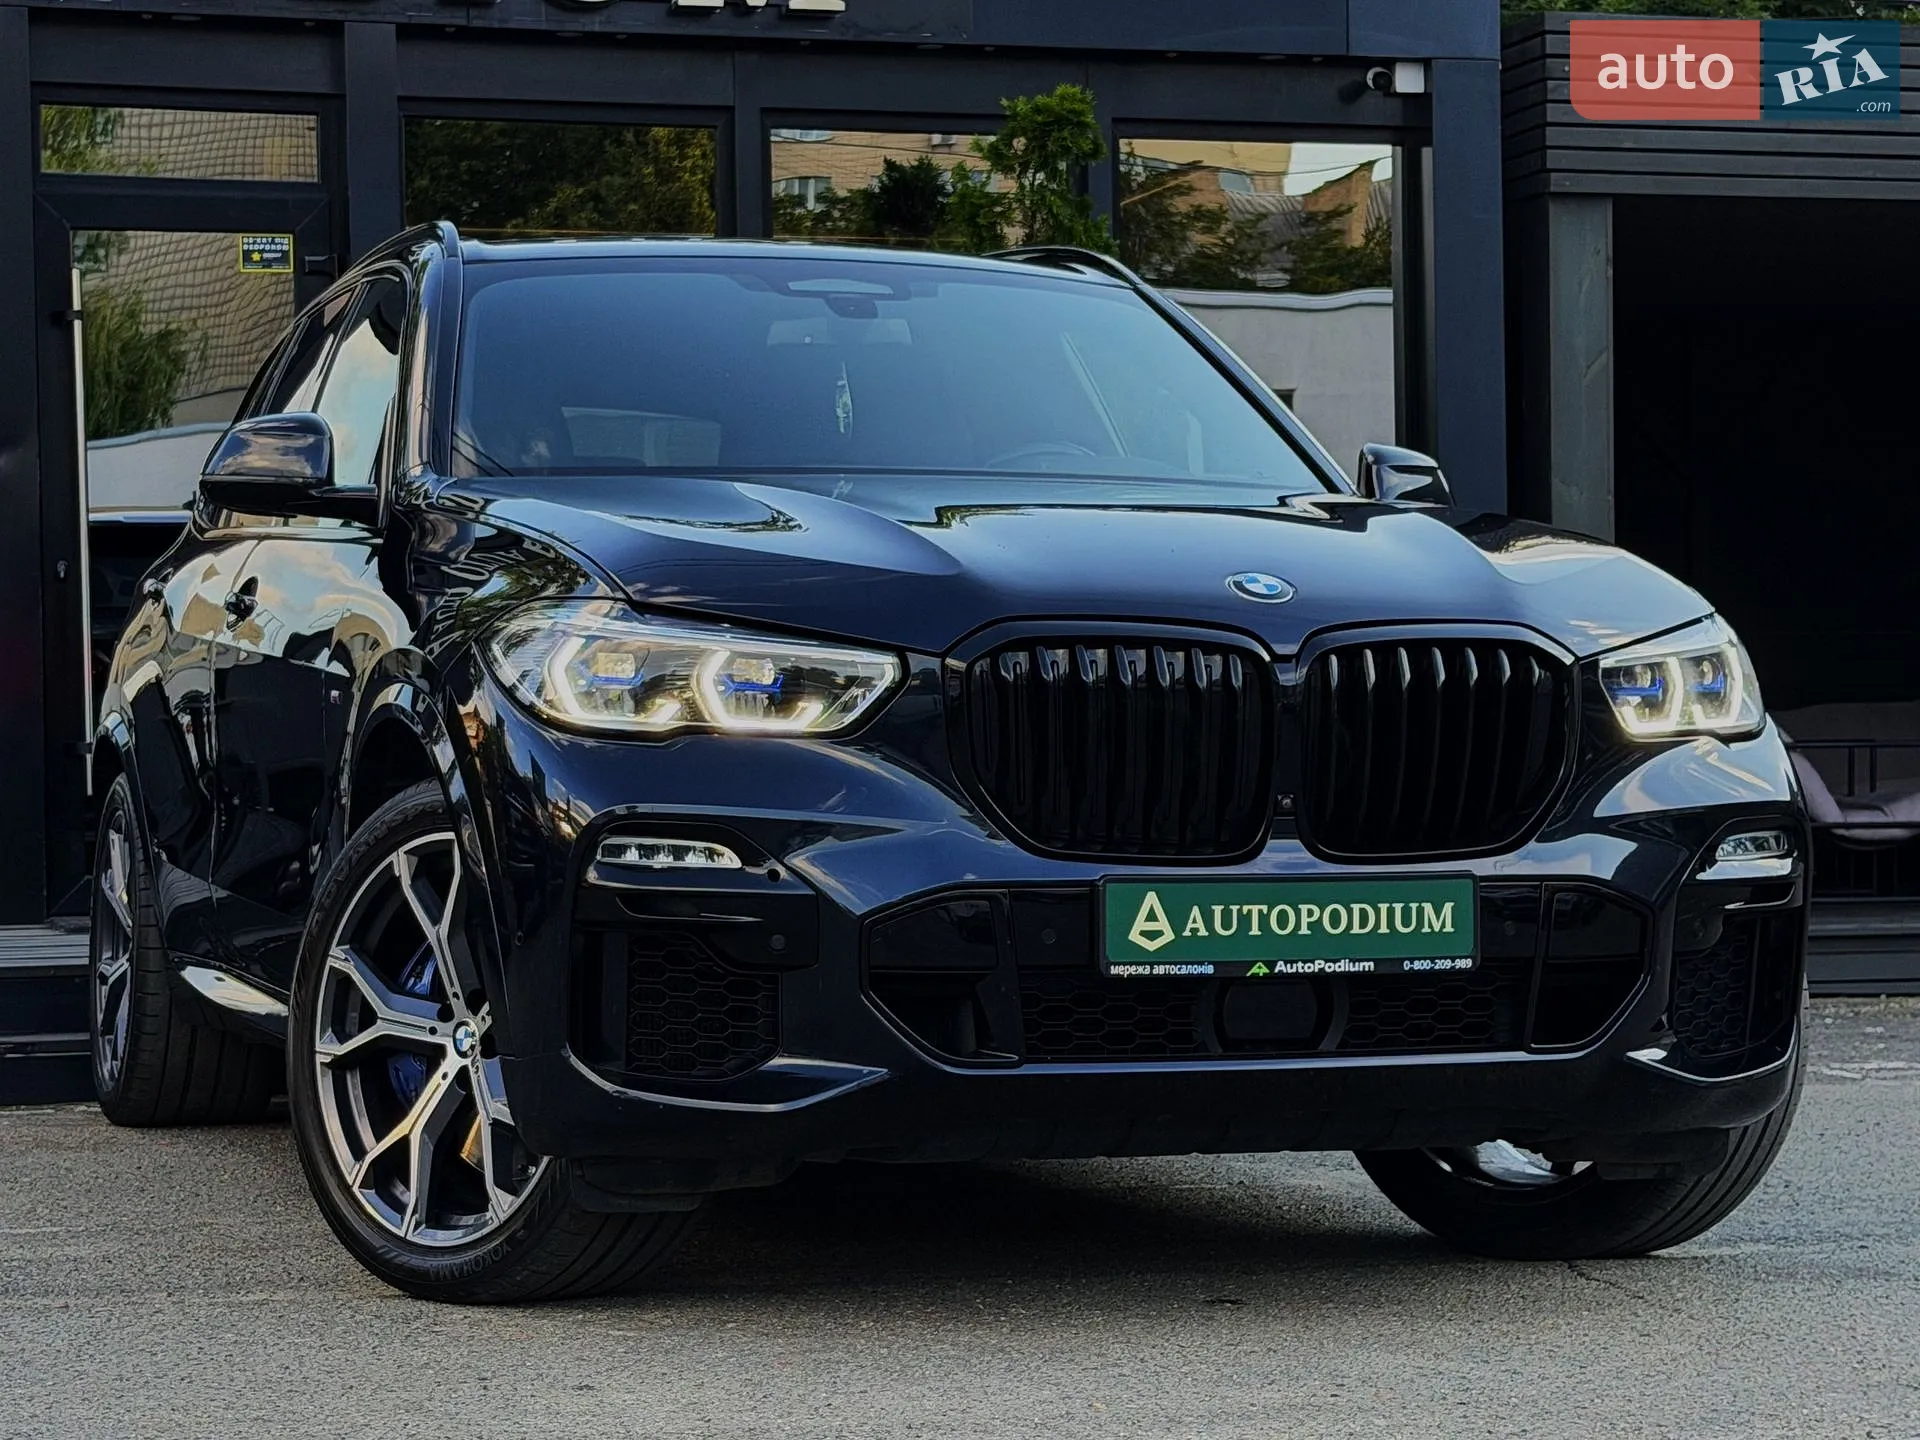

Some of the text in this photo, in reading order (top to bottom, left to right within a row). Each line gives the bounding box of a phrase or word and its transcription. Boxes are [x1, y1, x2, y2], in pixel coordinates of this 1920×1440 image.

[1182, 902, 1455, 937] AUTOPODIUM
[1110, 963, 1214, 977] мережа автосалонів
[1274, 960, 1374, 974] AutoPodium
[1403, 958, 1472, 970] 0-800-209-989
